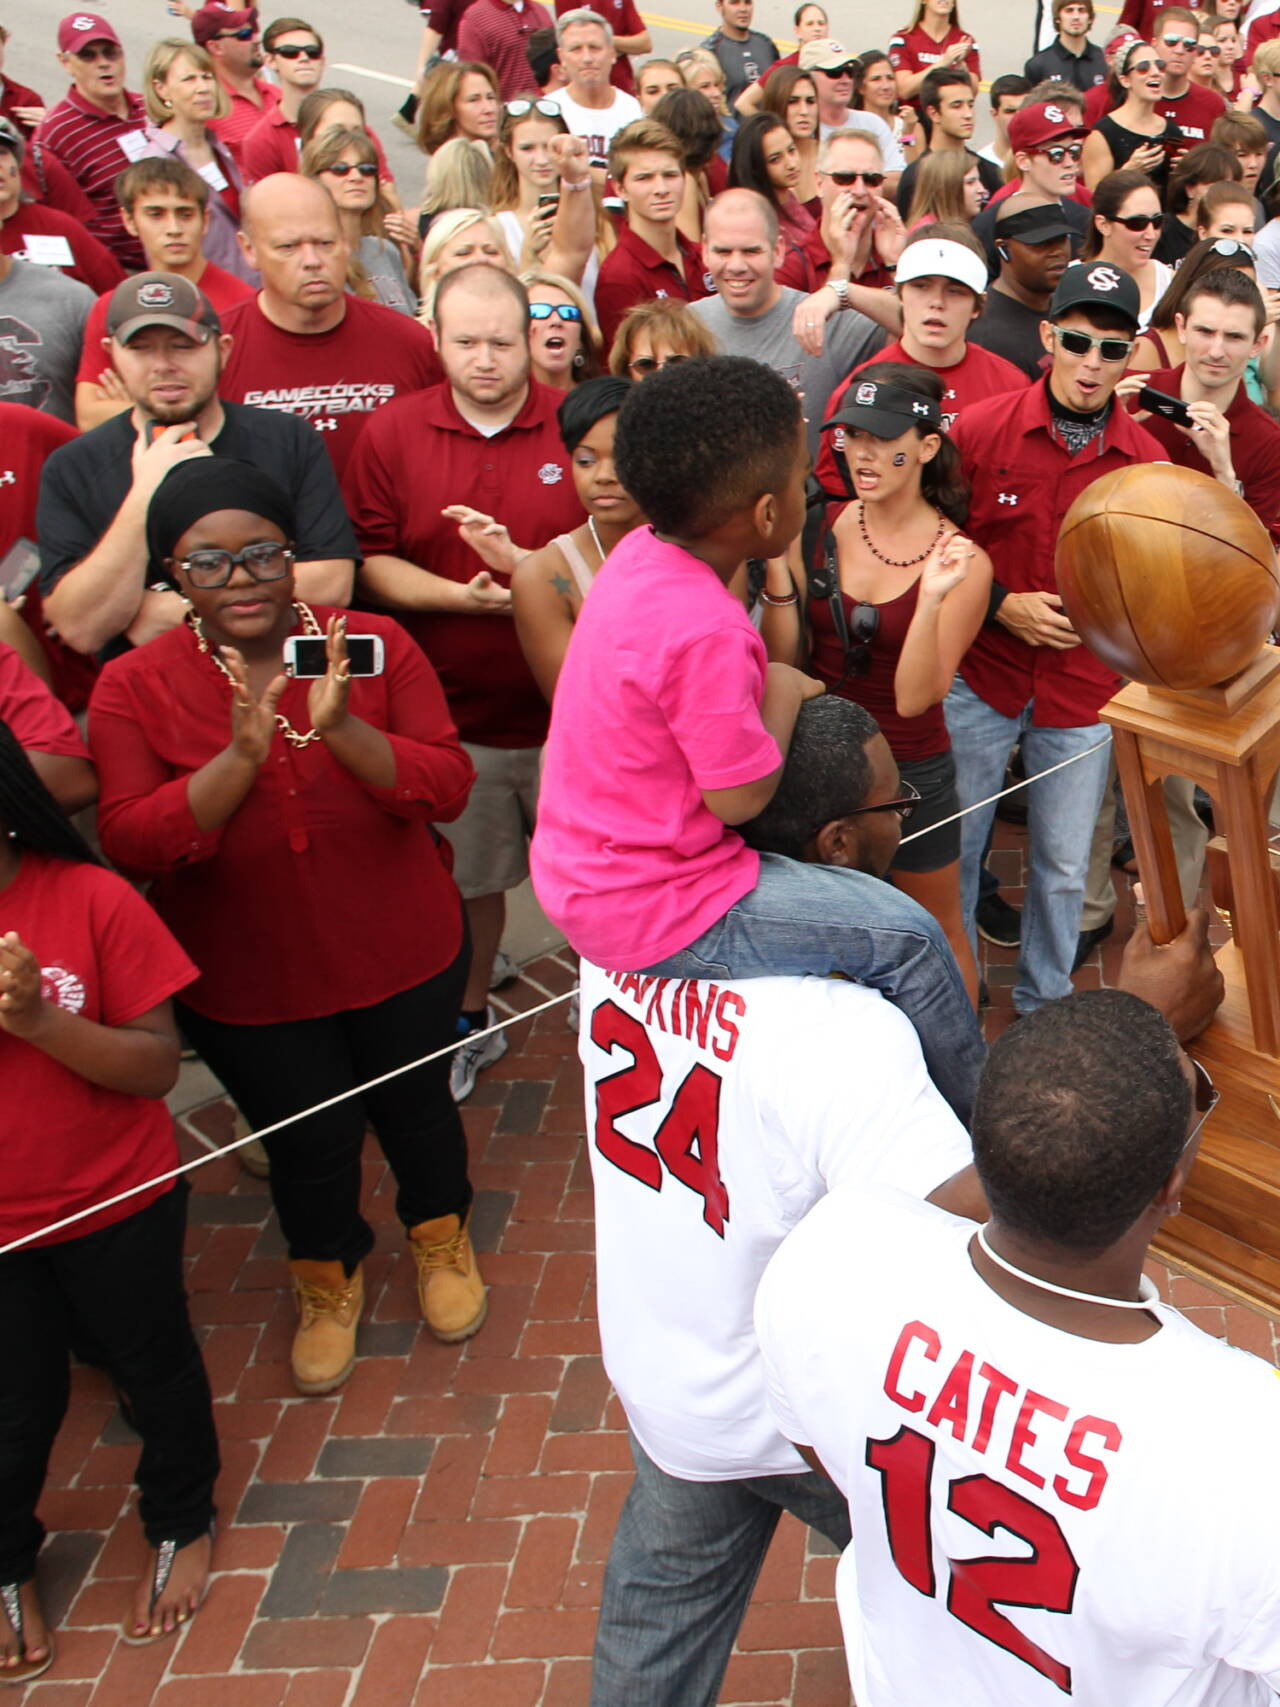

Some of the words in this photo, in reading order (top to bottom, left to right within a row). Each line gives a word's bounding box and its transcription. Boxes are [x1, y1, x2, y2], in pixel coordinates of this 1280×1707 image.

[243, 381, 395, 405] GAMECOCKS
[590, 998, 730, 1240] 24
[883, 1320, 1122, 1512] CATES
[865, 1424, 1081, 1697] 12
